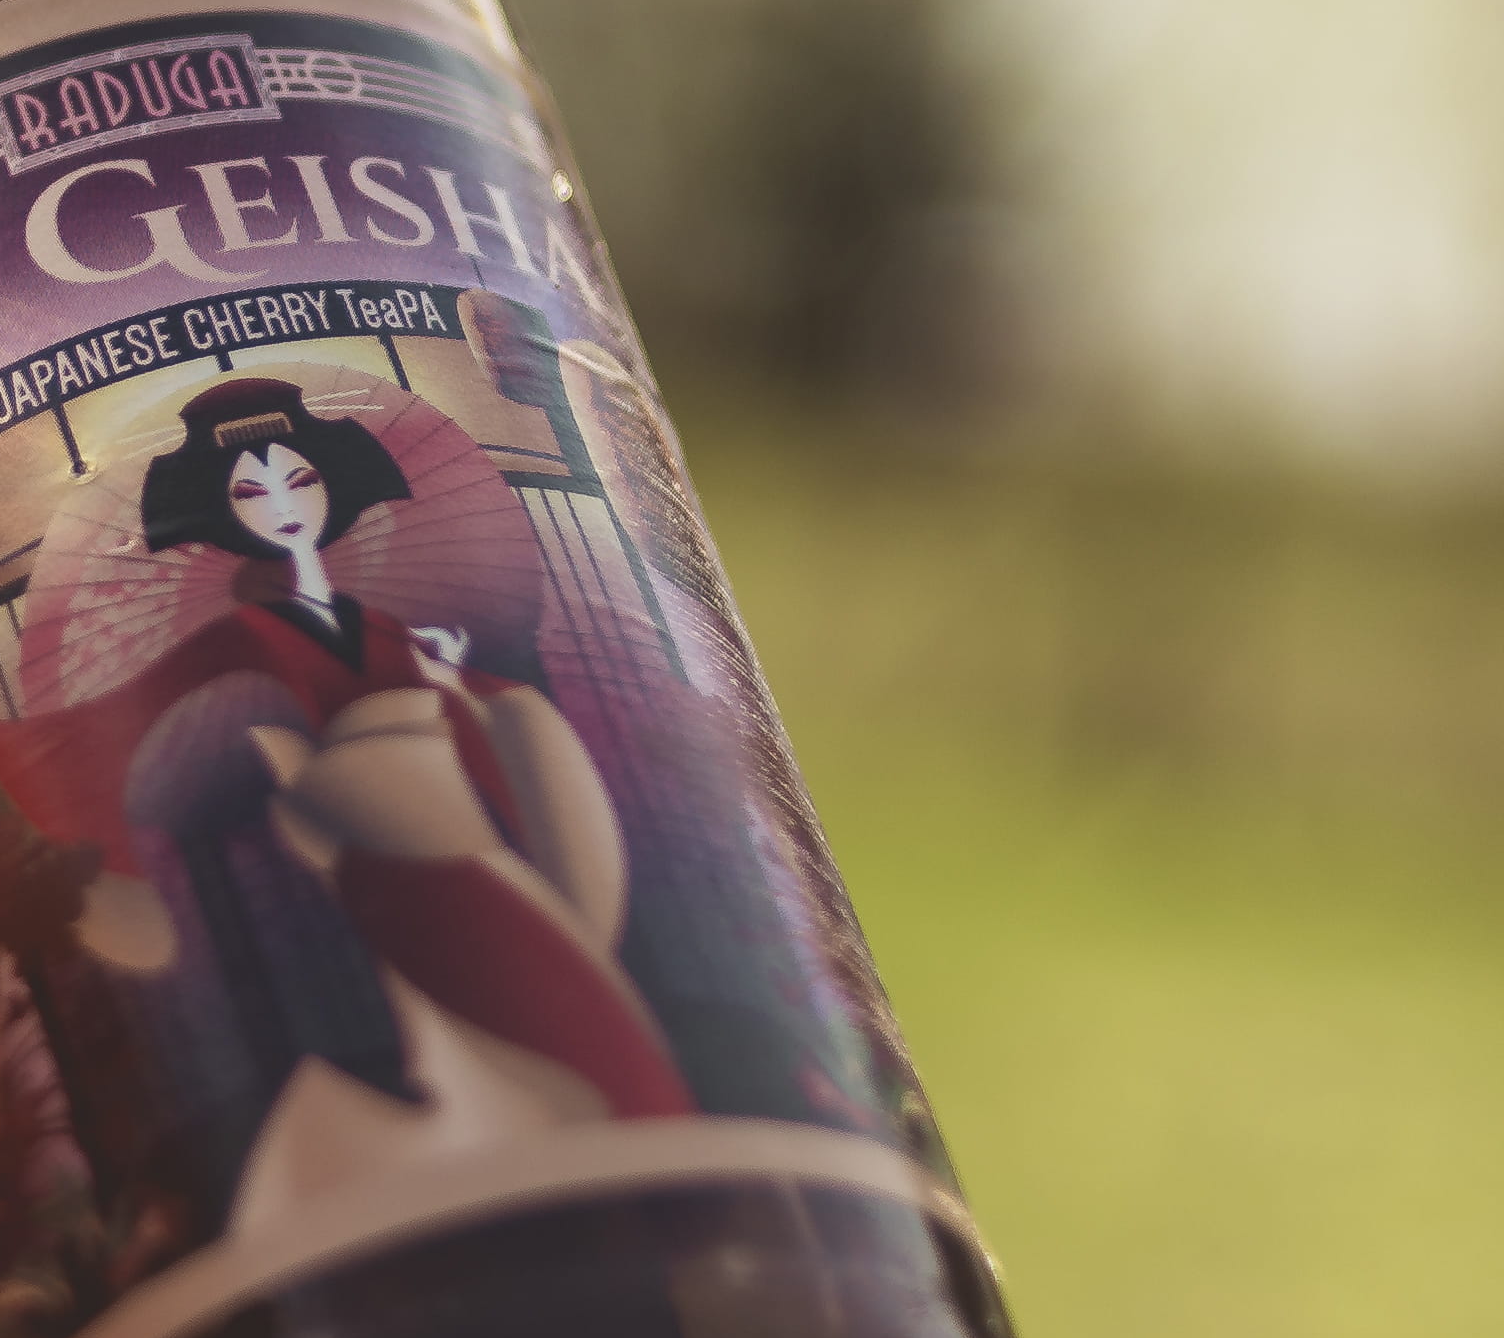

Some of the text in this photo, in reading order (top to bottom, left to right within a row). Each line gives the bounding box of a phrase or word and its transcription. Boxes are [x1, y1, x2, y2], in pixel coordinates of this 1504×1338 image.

[12, 49, 249, 151] RADUGA
[24, 154, 614, 321] GEISHA
[181, 291, 331, 352] CHERRY
[335, 287, 448, 333] TeaPA
